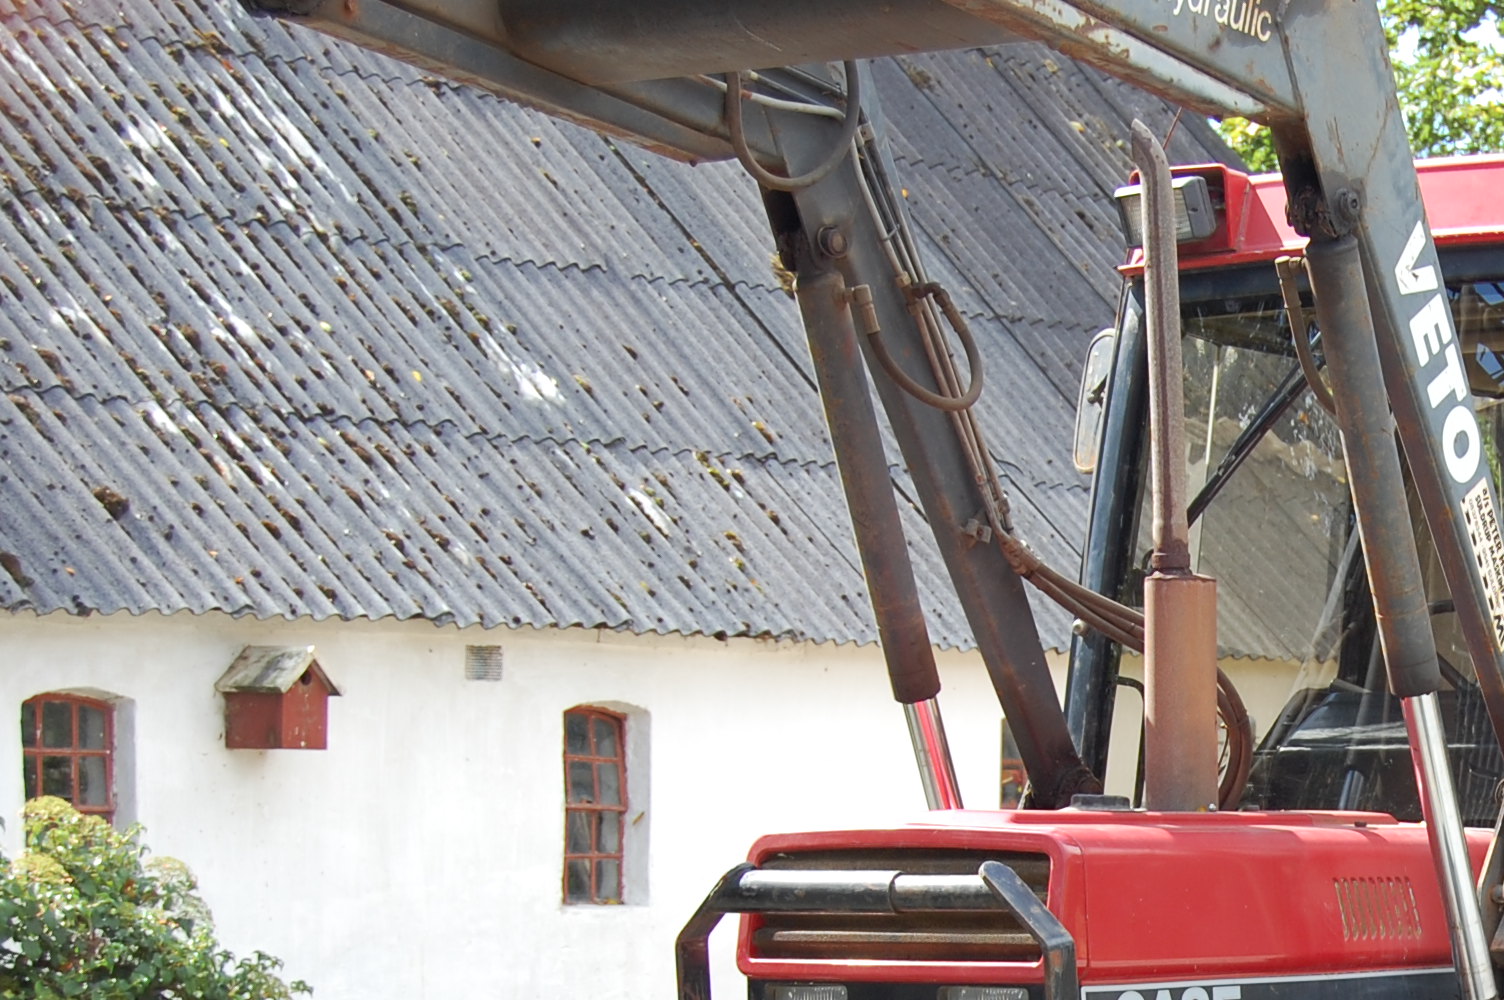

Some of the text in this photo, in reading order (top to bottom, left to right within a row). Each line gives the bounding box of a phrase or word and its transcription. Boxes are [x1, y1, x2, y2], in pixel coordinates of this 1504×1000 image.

[1167, 0, 1272, 42] raulic
[1395, 219, 1481, 484] VETO
[1475, 494, 1492, 542] SULDRUP
[1486, 508, 1503, 554] PETER
